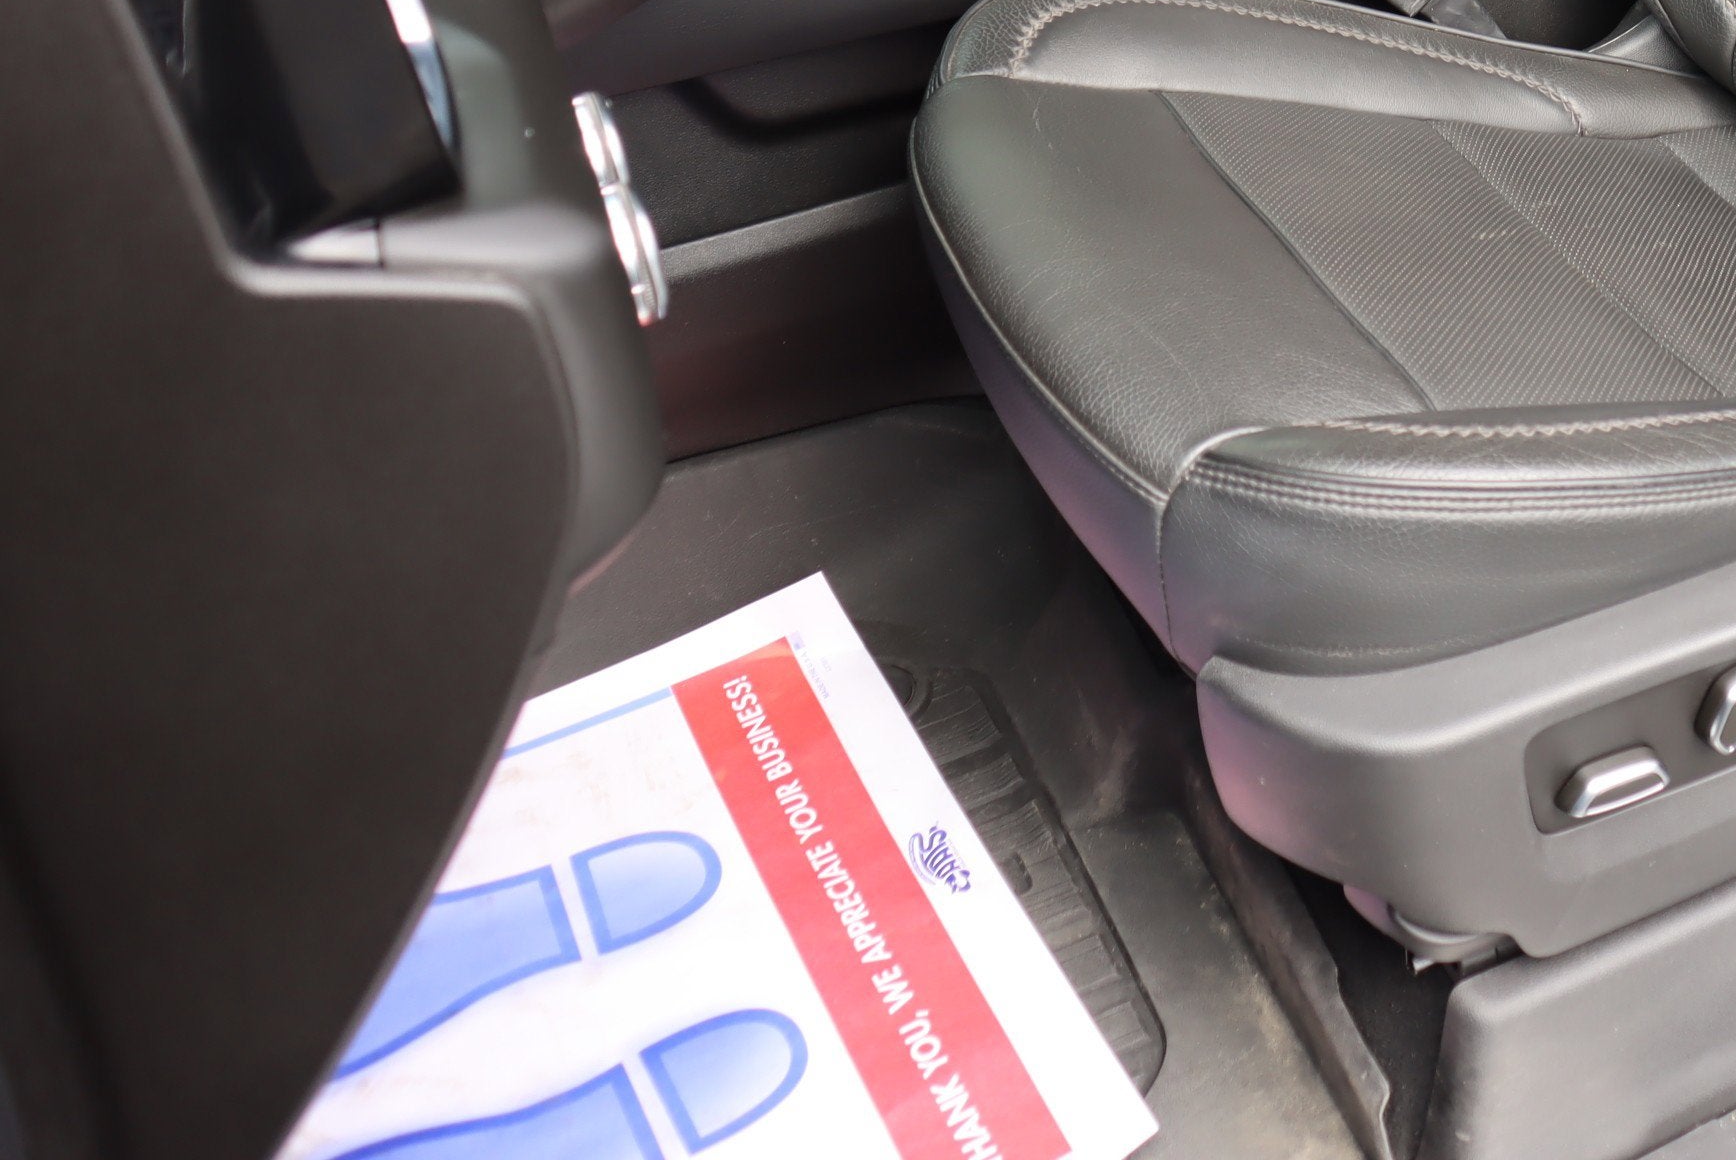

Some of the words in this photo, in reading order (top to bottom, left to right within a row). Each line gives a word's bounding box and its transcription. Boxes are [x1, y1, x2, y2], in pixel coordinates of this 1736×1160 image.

[724, 676, 793, 781] BUSINESS!
[776, 779, 823, 844] YOUR
[806, 840, 893, 964] APPRECIATE
[872, 964, 914, 1015] WE
[899, 1010, 948, 1080] YOU,
[930, 1073, 1003, 1160] HANK
